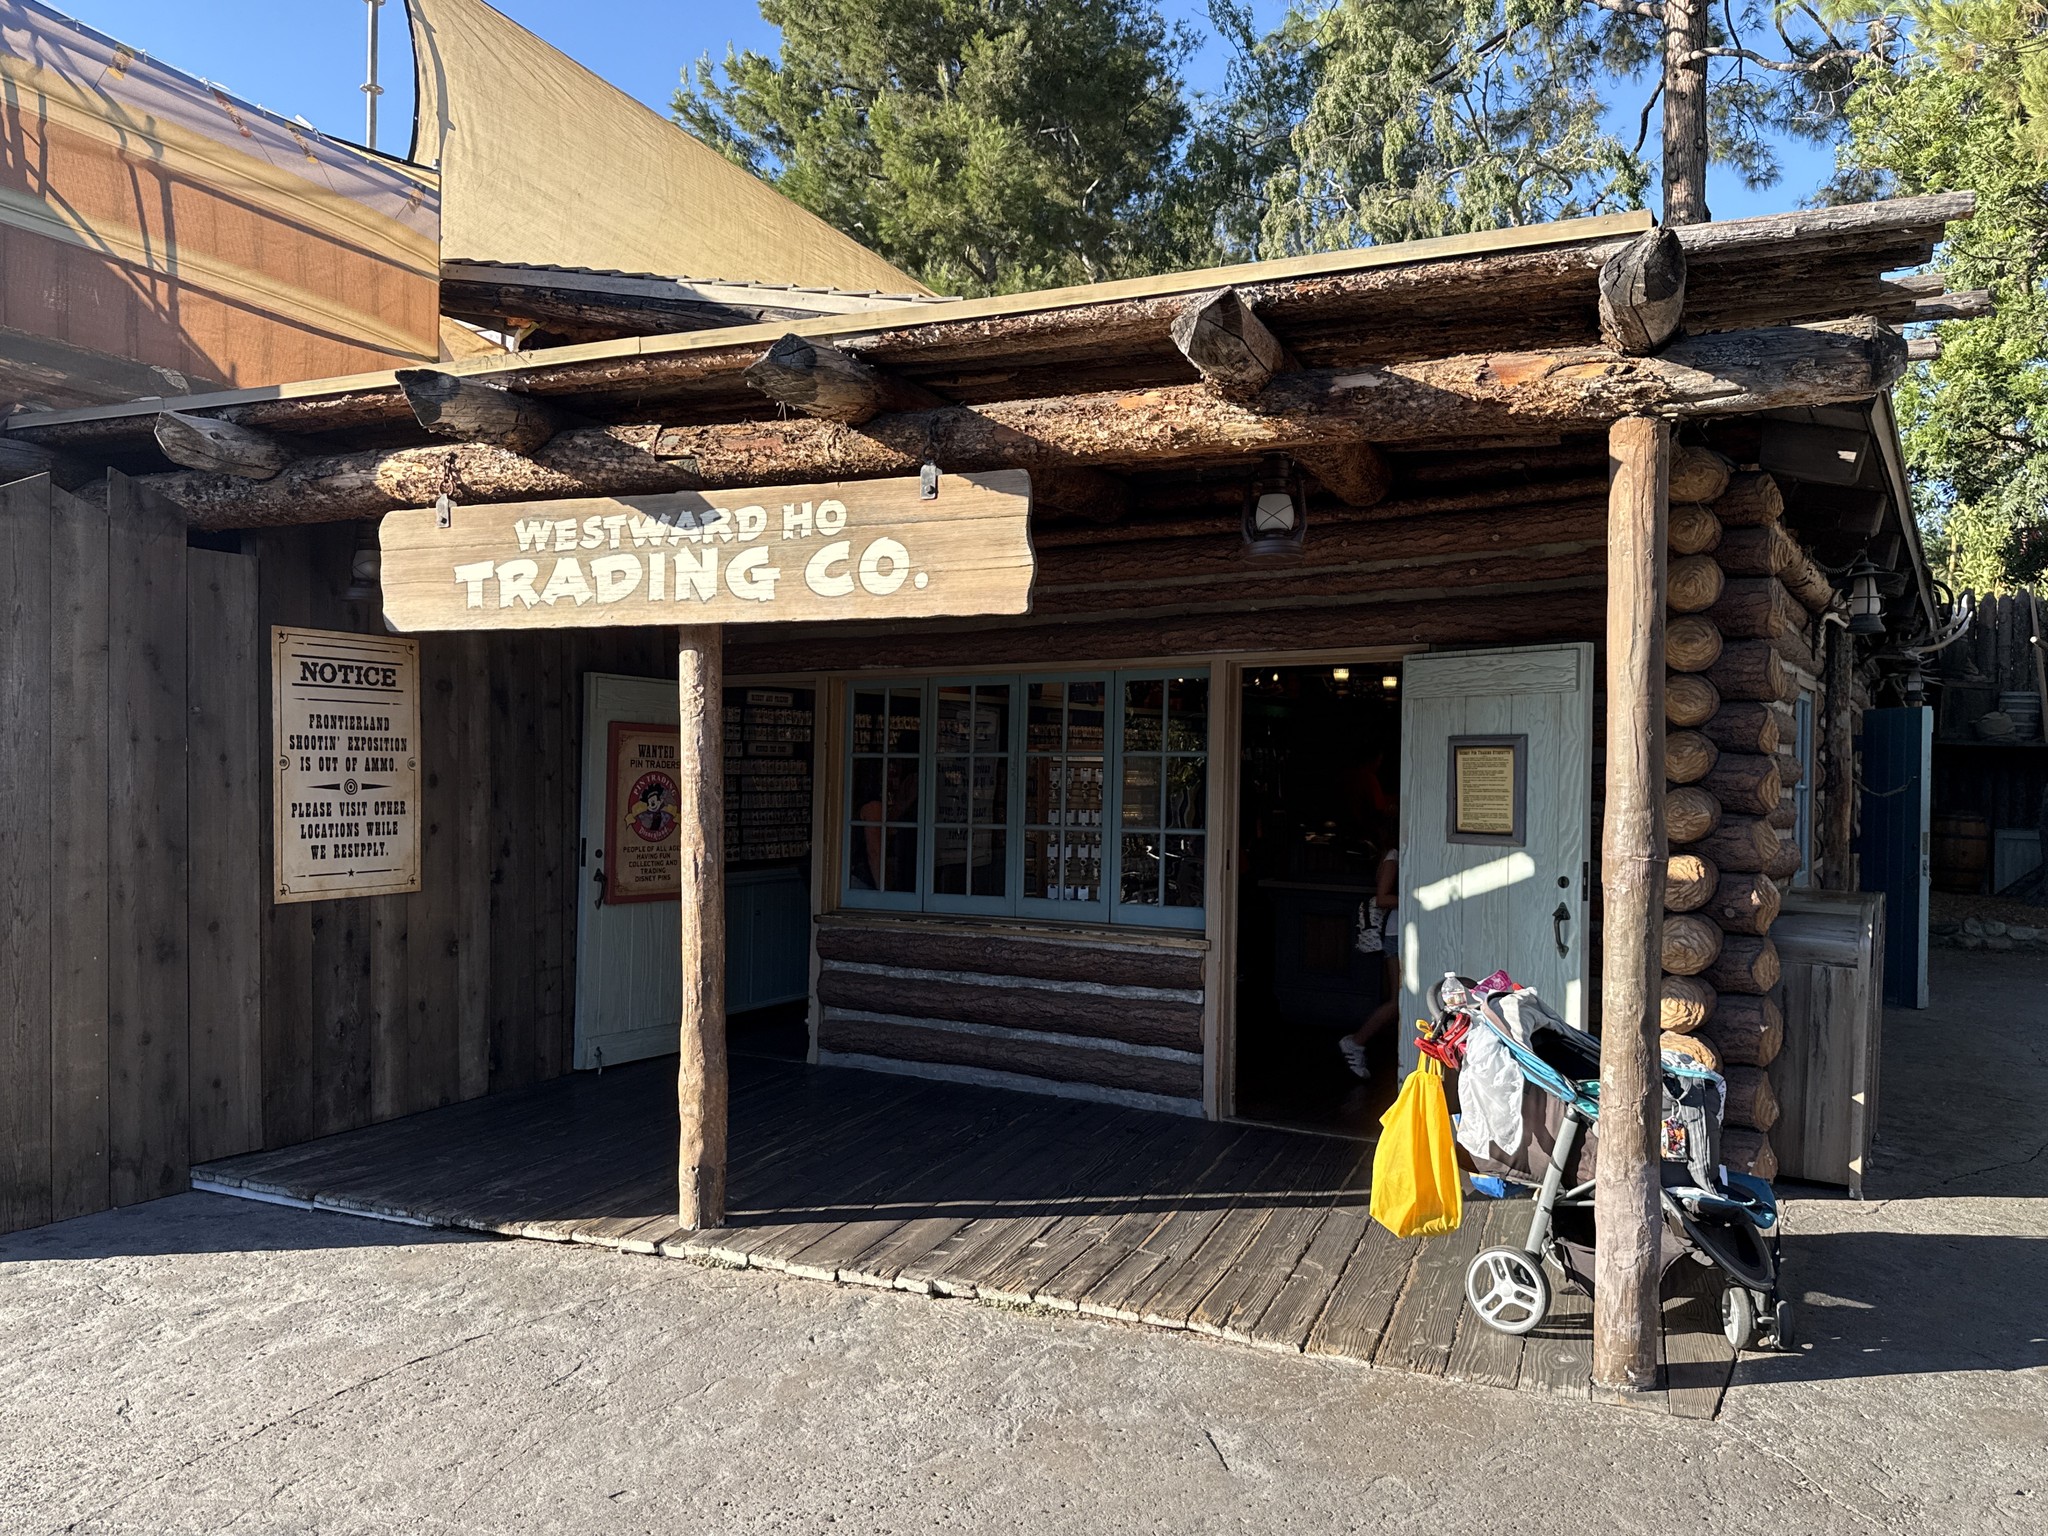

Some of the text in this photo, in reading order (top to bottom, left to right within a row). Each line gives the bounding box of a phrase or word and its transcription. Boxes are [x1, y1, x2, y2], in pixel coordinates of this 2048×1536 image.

[513, 499, 848, 553] WESTWARD HO
[453, 536, 929, 610] TRADING CO.
[300, 661, 396, 687] NOTICE
[309, 714, 390, 731] FRONTIERLAND
[289, 735, 407, 752] SHOOTIN' EXPOSITION
[638, 744, 675, 759] WANTED
[300, 757, 398, 772] IS OUT OF AMMO.
[630, 759, 680, 769] PIN TRADERS
[291, 801, 406, 818] PLEASE VISIT OTHER
[300, 821, 398, 839] LOCATIONS WHILE
[311, 841, 389, 860] WE RESUPPLY.
[623, 845, 646, 853] PEOPLE
[656, 844, 667, 852] ALL
[636, 852, 658, 860] HAVING
[628, 858, 678, 868] COLLECTING AND
[640, 867, 666, 875] TRADING
